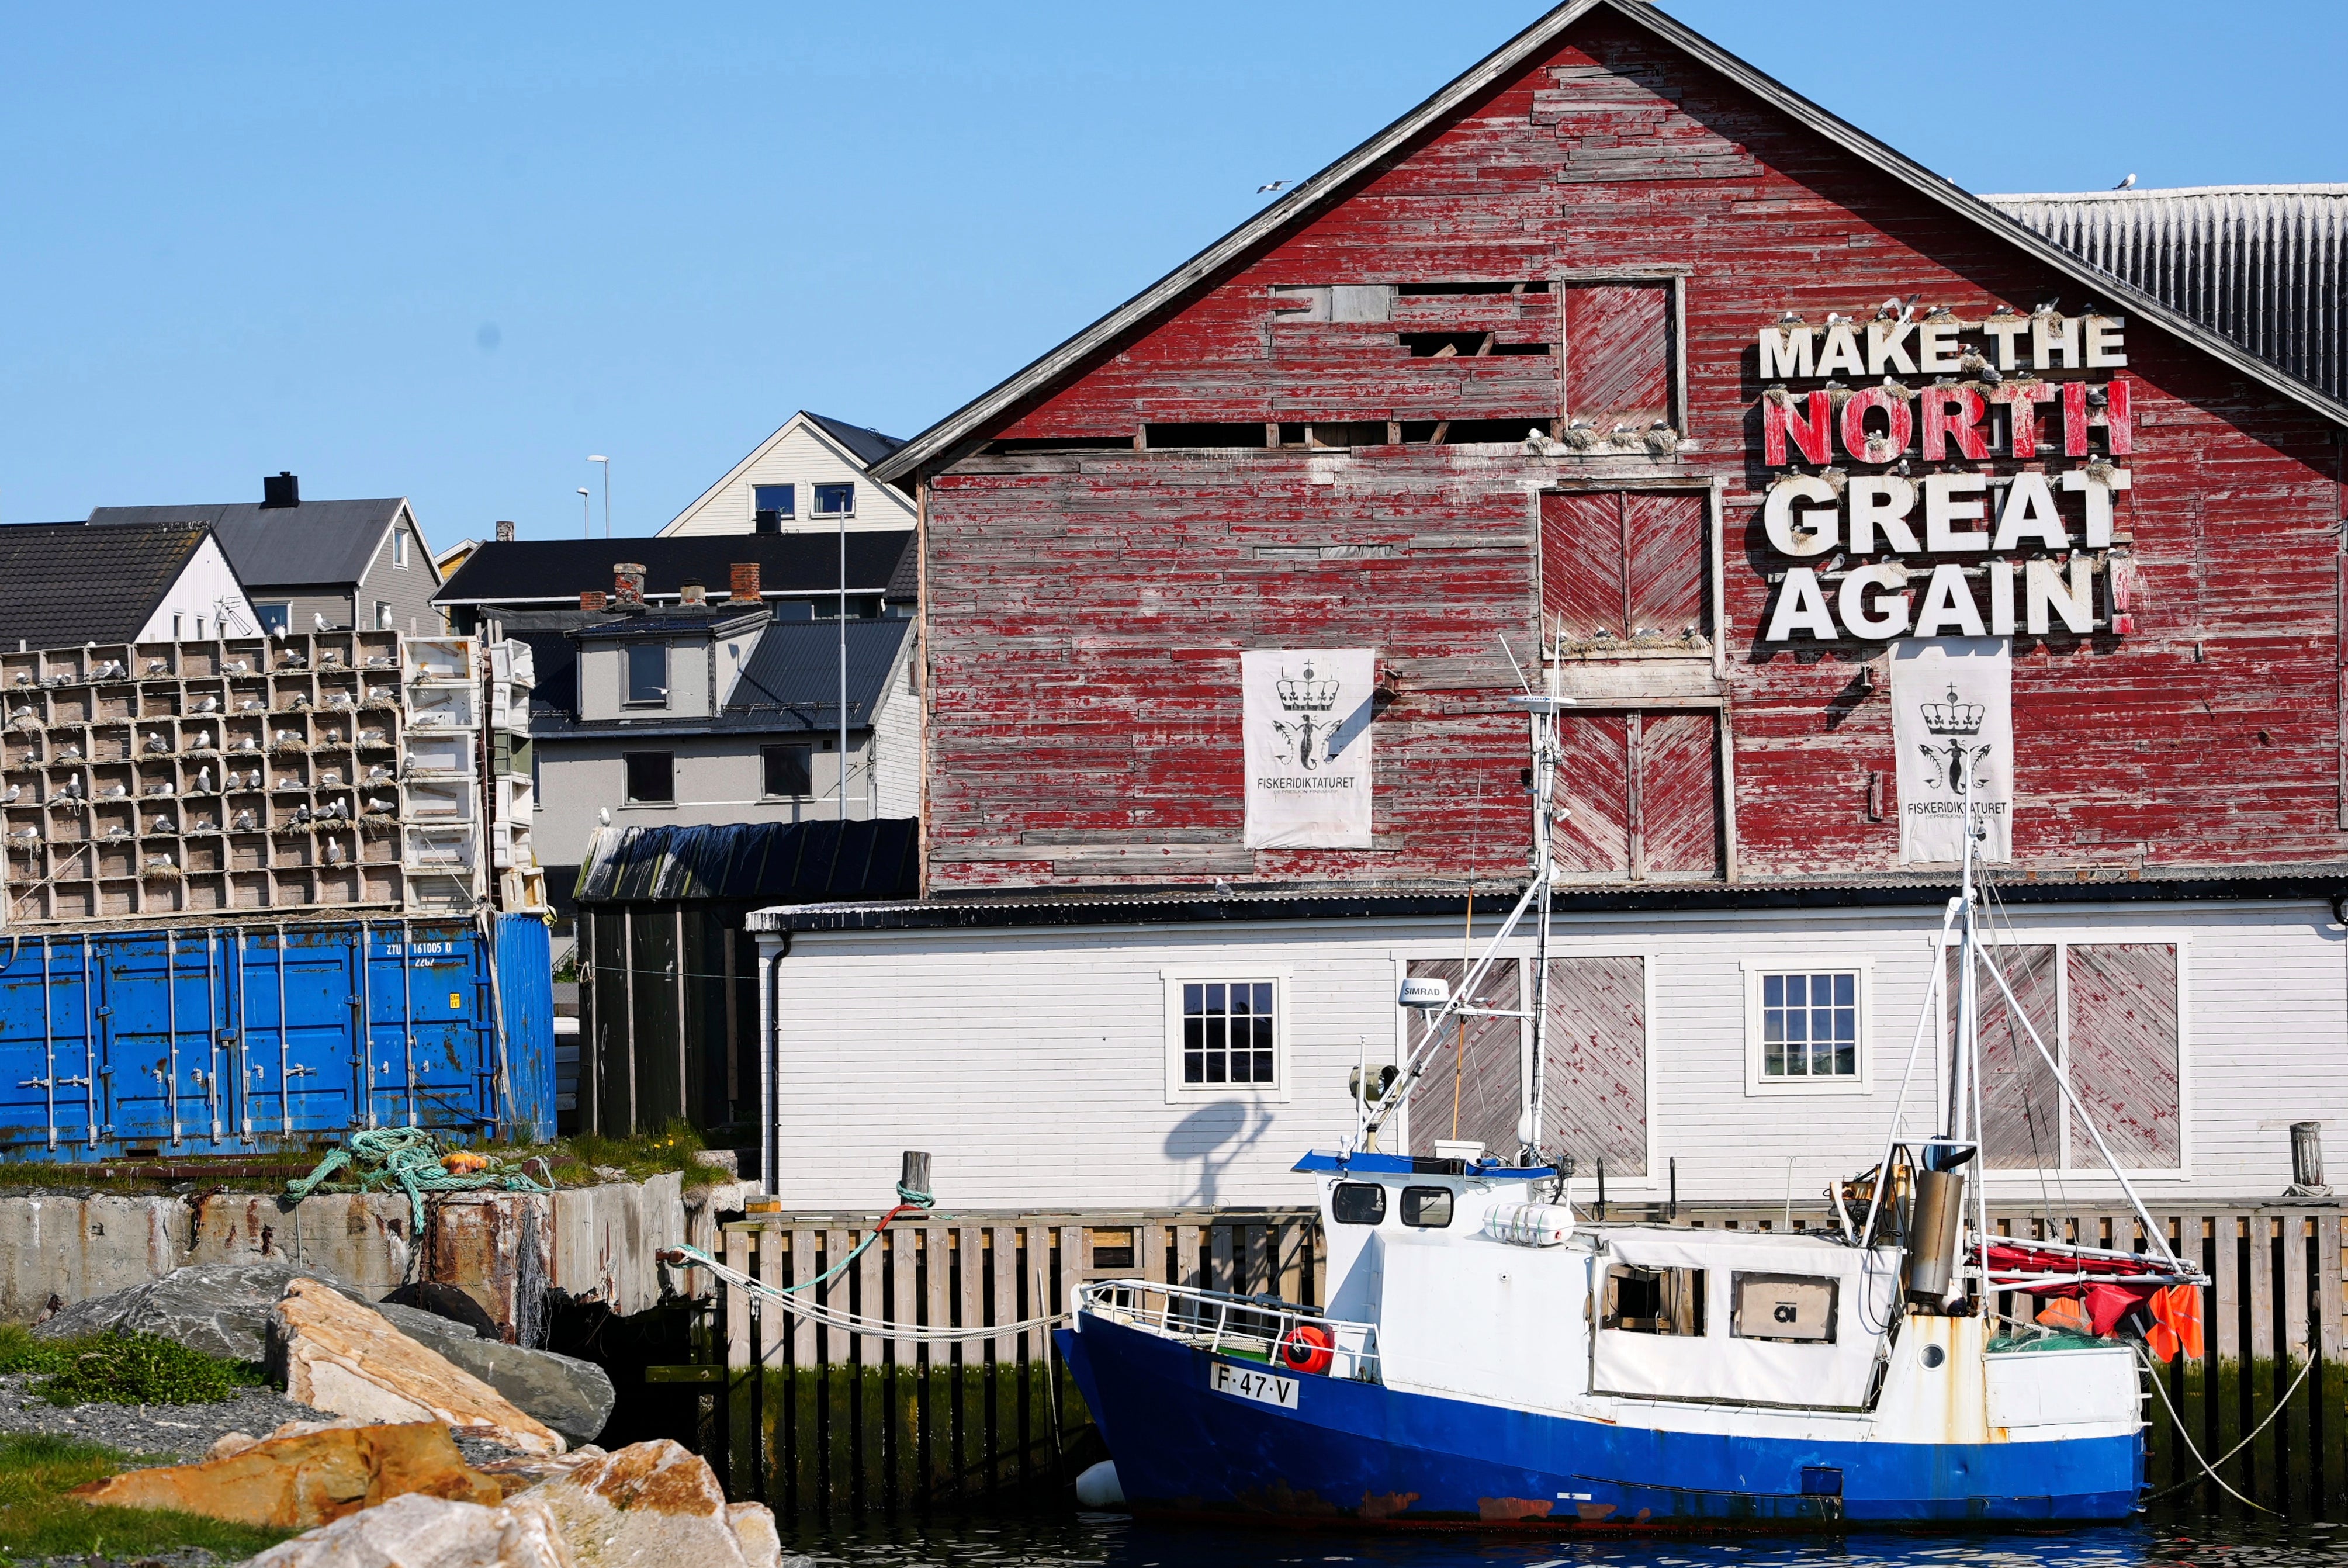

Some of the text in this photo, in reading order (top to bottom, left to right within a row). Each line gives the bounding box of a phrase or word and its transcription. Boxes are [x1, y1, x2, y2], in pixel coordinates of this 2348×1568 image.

[1759, 317, 2127, 378] MAKE THE
[1762, 380, 2132, 466] NORTH
[1764, 469, 2131, 556] GREAT
[1765, 560, 2134, 641] AGAIN!
[1258, 777, 1355, 789] FISKERIDIKTATURET
[413, 942, 442, 954] 161005
[1405, 987, 1440, 995] SIMRAD
